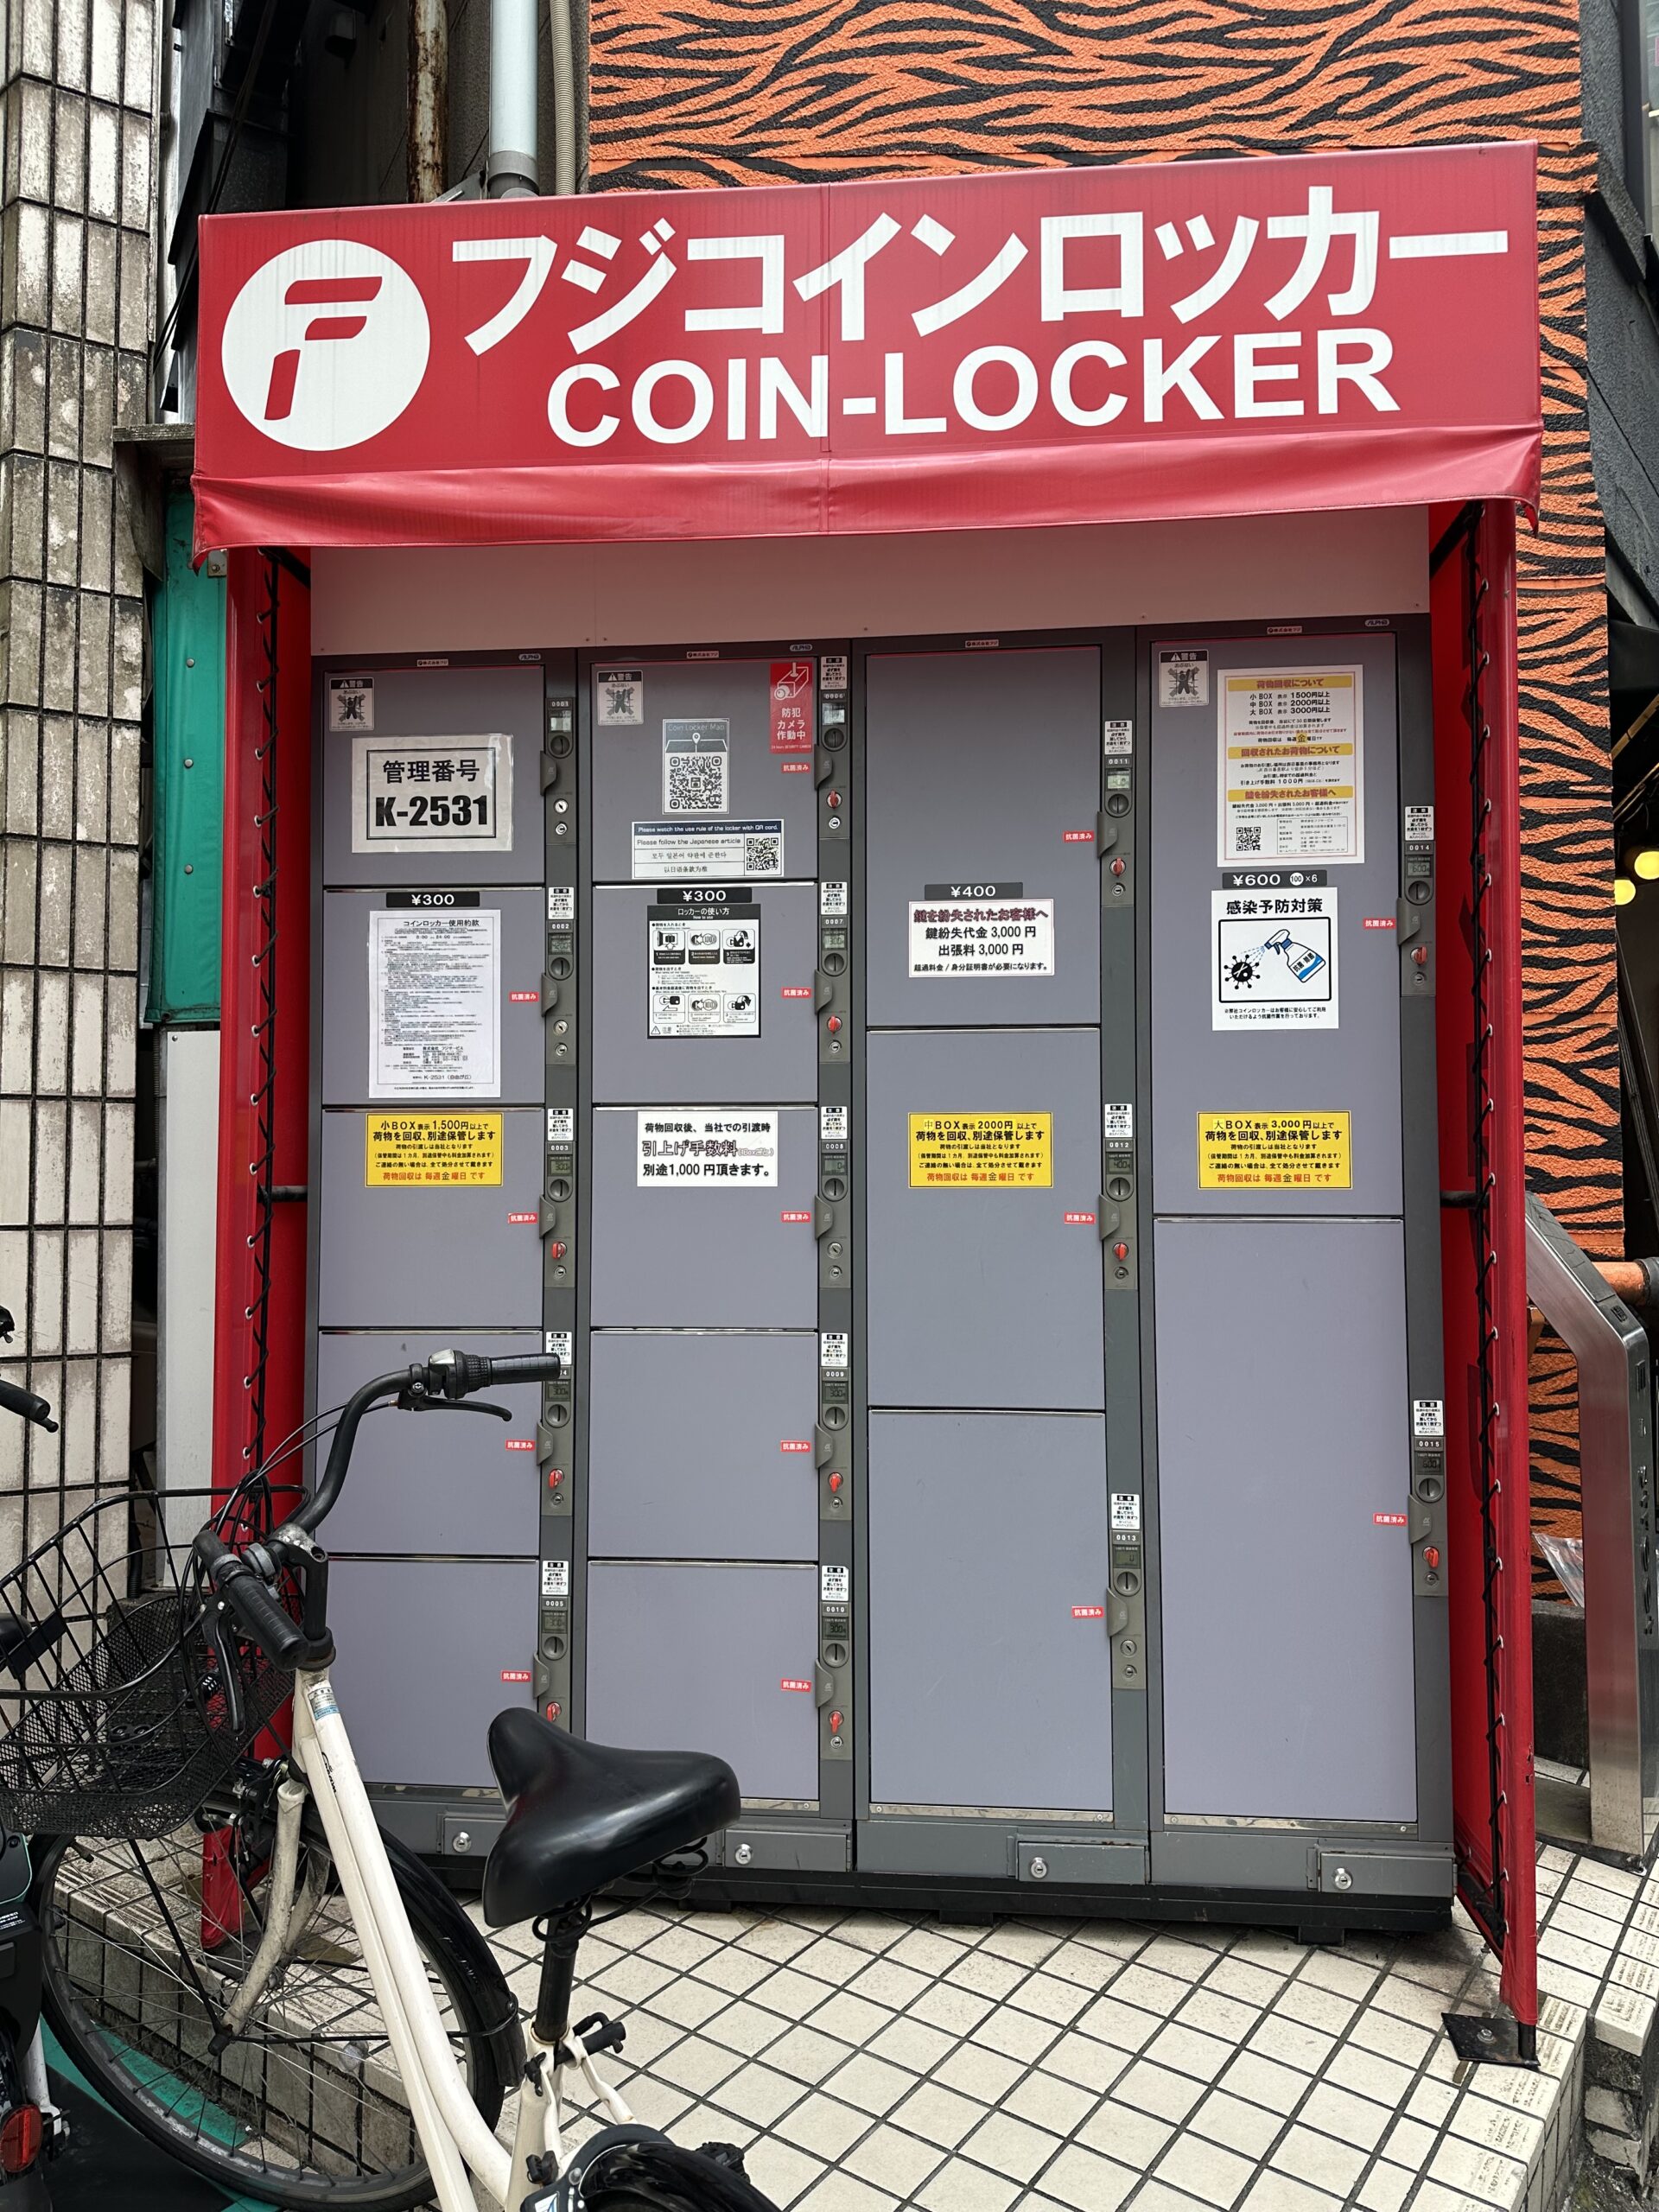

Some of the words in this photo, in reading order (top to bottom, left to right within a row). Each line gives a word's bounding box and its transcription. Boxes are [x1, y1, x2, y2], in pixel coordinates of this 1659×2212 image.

[452, 186, 1509, 355] フジコインロッカー
[547, 328, 1402, 448] COIN-LOCKER
[1256, 678, 1325, 689] 荷物回収について
[782, 708, 801, 717] 防犯
[778, 720, 804, 729] カメラ
[777, 730, 805, 740] 作動中
[1241, 747, 1340, 757] 回収されたお荷物について
[383, 759, 480, 784] 管理番号
[375, 795, 487, 826] K-2531
[1233, 874, 1281, 887] ¥600
[683, 890, 727, 901] ¥300
[950, 886, 996, 898] ¥400
[411, 894, 454, 906] ¥300
[677, 907, 730, 916] ロッカーの使い方
[1226, 899, 1323, 915] 感染予防対策
[914, 907, 1049, 923] 鍵を紛失されたお客様へ
[925, 927, 988, 939] 鍵紛失代金
[991, 926, 1021, 938] 3,000
[1025, 926, 1036, 938] 円
[938, 944, 975, 957] 出張料
[978, 944, 1008, 957] 3,000
[1012, 944, 1024, 955] 円
[645, 1123, 697, 1133] 荷物回収後、
[705, 1122, 771, 1133] 当社での引渡時
[373, 1131, 496, 1141] 荷物を回収、別途保管します
[916, 1130, 1045, 1141] 荷物を回収、別途保管します
[1205, 1130, 1342, 1141] 荷物を回収、別途保管します
